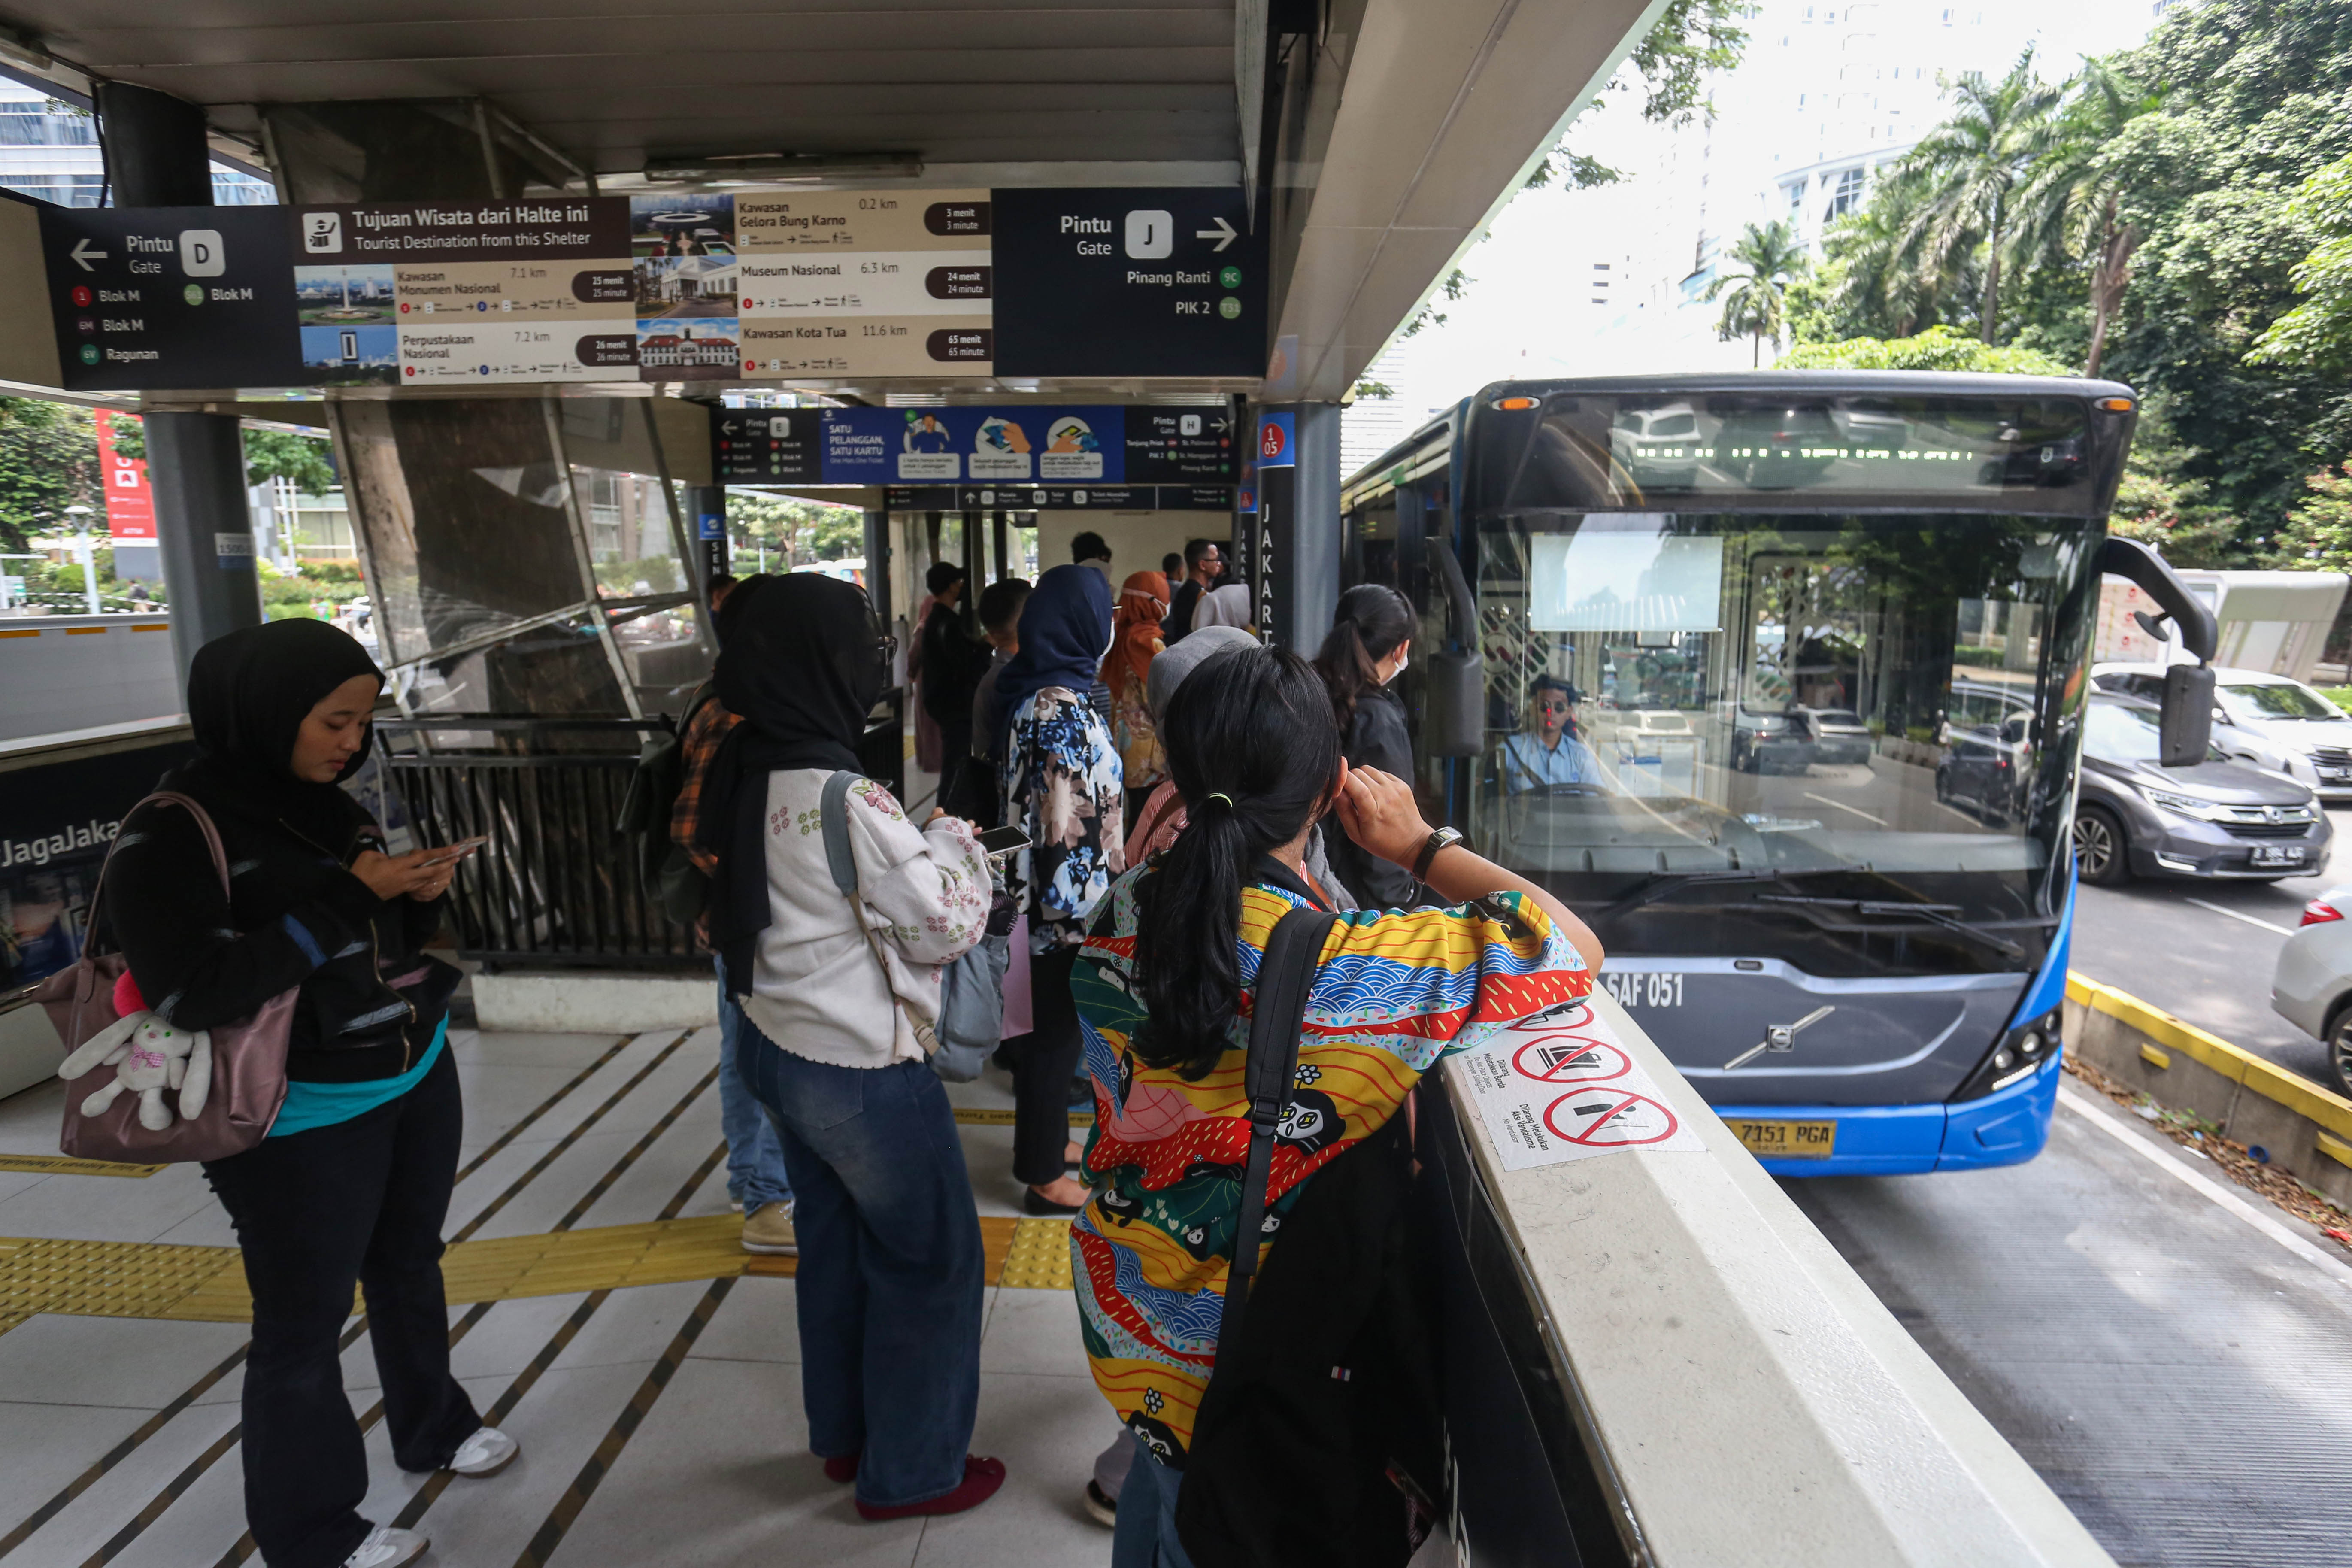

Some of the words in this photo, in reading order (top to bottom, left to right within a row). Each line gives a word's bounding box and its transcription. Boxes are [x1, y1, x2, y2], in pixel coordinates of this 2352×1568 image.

[739, 203, 790, 213] Kawasan
[859, 199, 876, 210] 0.2
[880, 198, 898, 209] km
[352, 211, 412, 232] Tujuan
[415, 209, 473, 226] Wisata
[478, 207, 511, 224] dari
[515, 206, 562, 223] Halte
[566, 205, 589, 222] ini
[946, 208, 952, 217] 3
[953, 208, 976, 217] menit
[740, 216, 776, 227] Gelora
[779, 215, 809, 229] Bung
[812, 215, 846, 226] Karno
[947, 221, 952, 230] 3
[953, 221, 979, 230] minute
[1061, 215, 1112, 234] Pintu
[1143, 224, 1153, 245] J
[354, 237, 401, 250] Tourist
[403, 235, 478, 249] Destination
[481, 234, 512, 247] from
[515, 232, 540, 246] this
[543, 231, 591, 246] Shelter
[126, 235, 174, 252] Pintu
[194, 243, 209, 264] D
[1076, 240, 1112, 255] Gate
[129, 260, 162, 273] Gate
[741, 265, 788, 276] Museum
[792, 264, 841, 276] Nasional
[860, 262, 878, 273] 6.3
[882, 262, 899, 273] km
[397, 271, 446, 282] Kawasan
[511, 267, 526, 279] 7.1
[530, 267, 547, 278] km
[947, 272, 958, 281] 24
[958, 272, 981, 281] menit
[1127, 271, 1173, 287] Pinang
[1176, 271, 1211, 284] Ranti
[592, 276, 602, 285] 25
[603, 276, 624, 285] menit
[211, 288, 239, 300] Blok
[240, 288, 253, 300] M
[399, 285, 452, 295] Monumen
[454, 282, 502, 294] Nasional
[593, 288, 602, 297] 25
[603, 288, 628, 297] minute
[947, 284, 958, 294] 24
[958, 284, 984, 294] minute
[98, 290, 127, 302] Blok
[127, 289, 141, 301] M
[1176, 301, 1199, 314] PIK
[1202, 301, 1210, 314] 2
[103, 319, 131, 331] Blok
[131, 319, 145, 331] M
[862, 325, 886, 336] 11.6
[889, 325, 907, 336] km
[515, 331, 530, 343] 7.2
[534, 331, 550, 342] km
[743, 328, 793, 339] Kawasan
[796, 327, 822, 338] Kota
[825, 326, 846, 337] Tua
[403, 334, 475, 347] Perpustakaan
[606, 340, 628, 349] menit
[948, 335, 958, 344] 65
[959, 334, 982, 344] menit
[106, 348, 159, 363] Ragunan
[403, 348, 450, 359] Nasional
[606, 352, 631, 361] minute
[948, 347, 958, 356] 65
[959, 347, 985, 356] minute
[828, 425, 852, 434] SATU
[1187, 421, 1195, 430] H
[1267, 428, 1273, 441] 1
[830, 446, 852, 455] SATU
[854, 446, 883, 455] KARTU
[1264, 441, 1278, 455] 05
[0, 819, 121, 867] JagaJaka
[1606, 973, 1643, 1007] SAF
[1647, 973, 1683, 1007] 051
[1497, 1059, 1510, 1077] Dilarang
[1494, 1075, 1506, 1089] Benda
[1511, 1111, 1524, 1121] Aksi
[1519, 1103, 1535, 1125] Dilarang
[1529, 1123, 1549, 1151] Melakukan
[1506, 1124, 1519, 1144] Vandalism
[1517, 1120, 1536, 1149] Vandalisme
[1741, 1125, 1786, 1143] 7151
[1797, 1125, 1830, 1144] PGA
